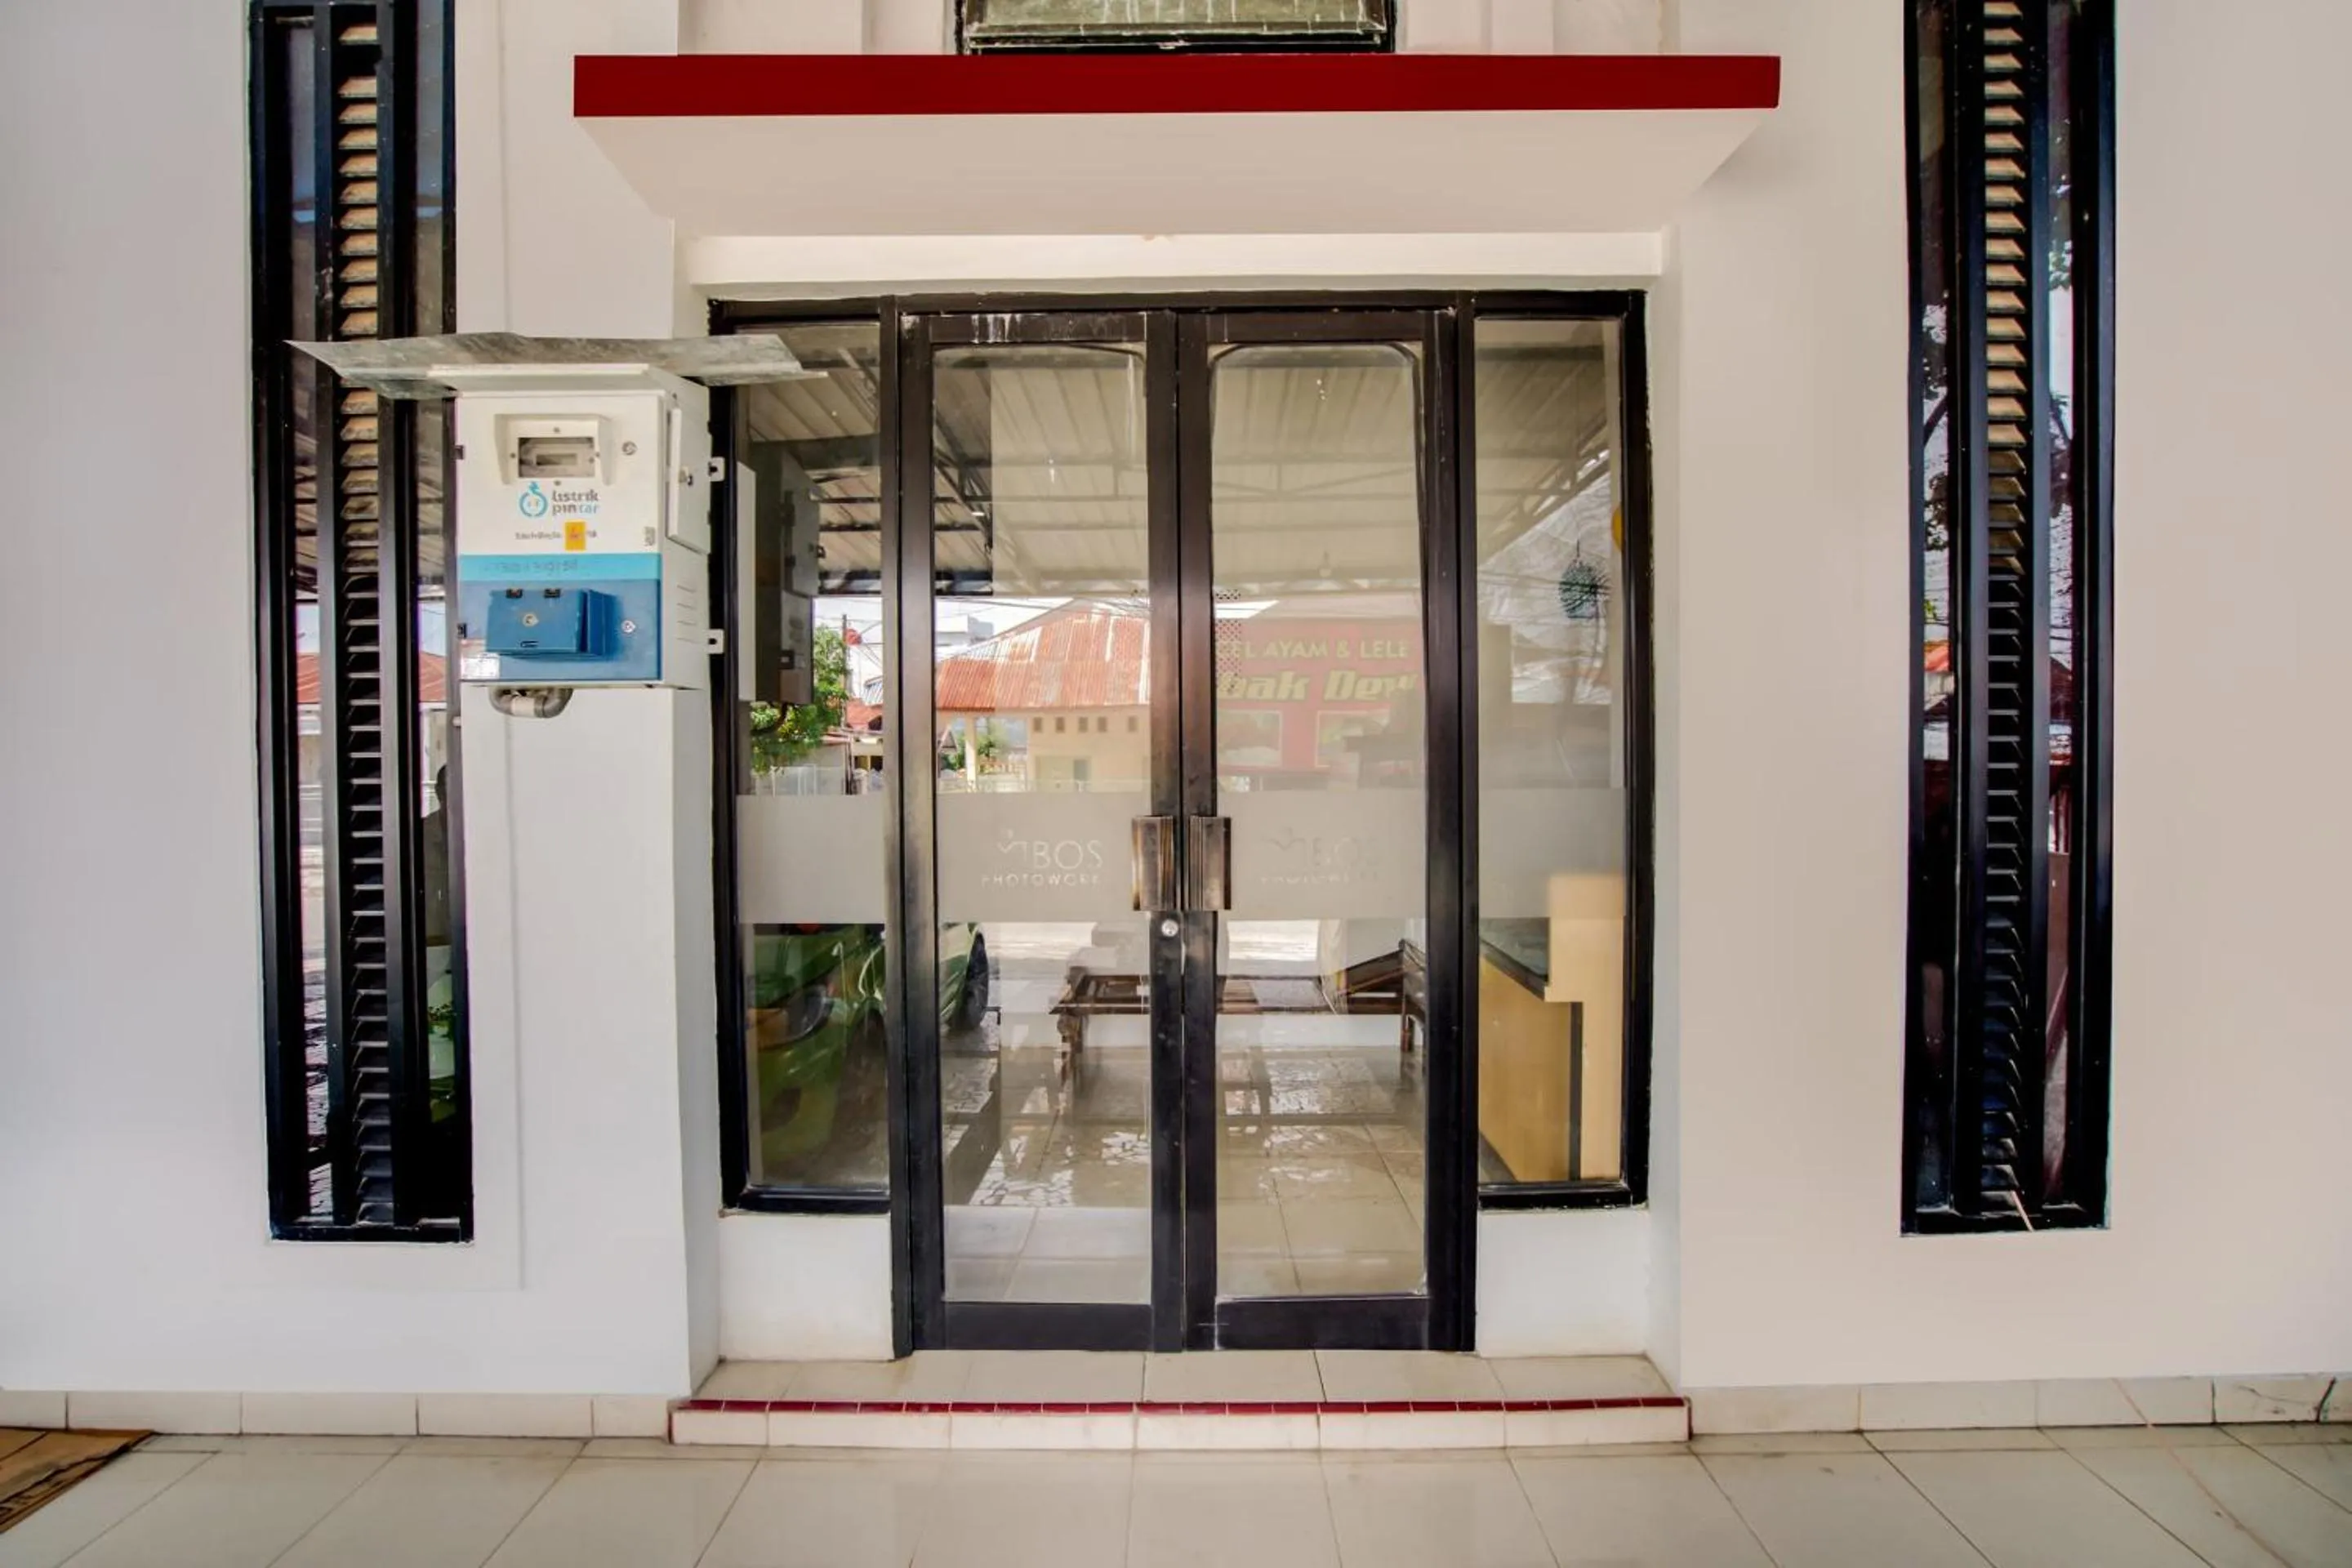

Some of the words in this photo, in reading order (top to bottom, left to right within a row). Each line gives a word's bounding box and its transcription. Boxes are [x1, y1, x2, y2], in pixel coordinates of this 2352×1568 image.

[551, 502, 600, 516] pintar
[1263, 639, 1329, 658] AYAM
[1360, 639, 1410, 658] LELE
